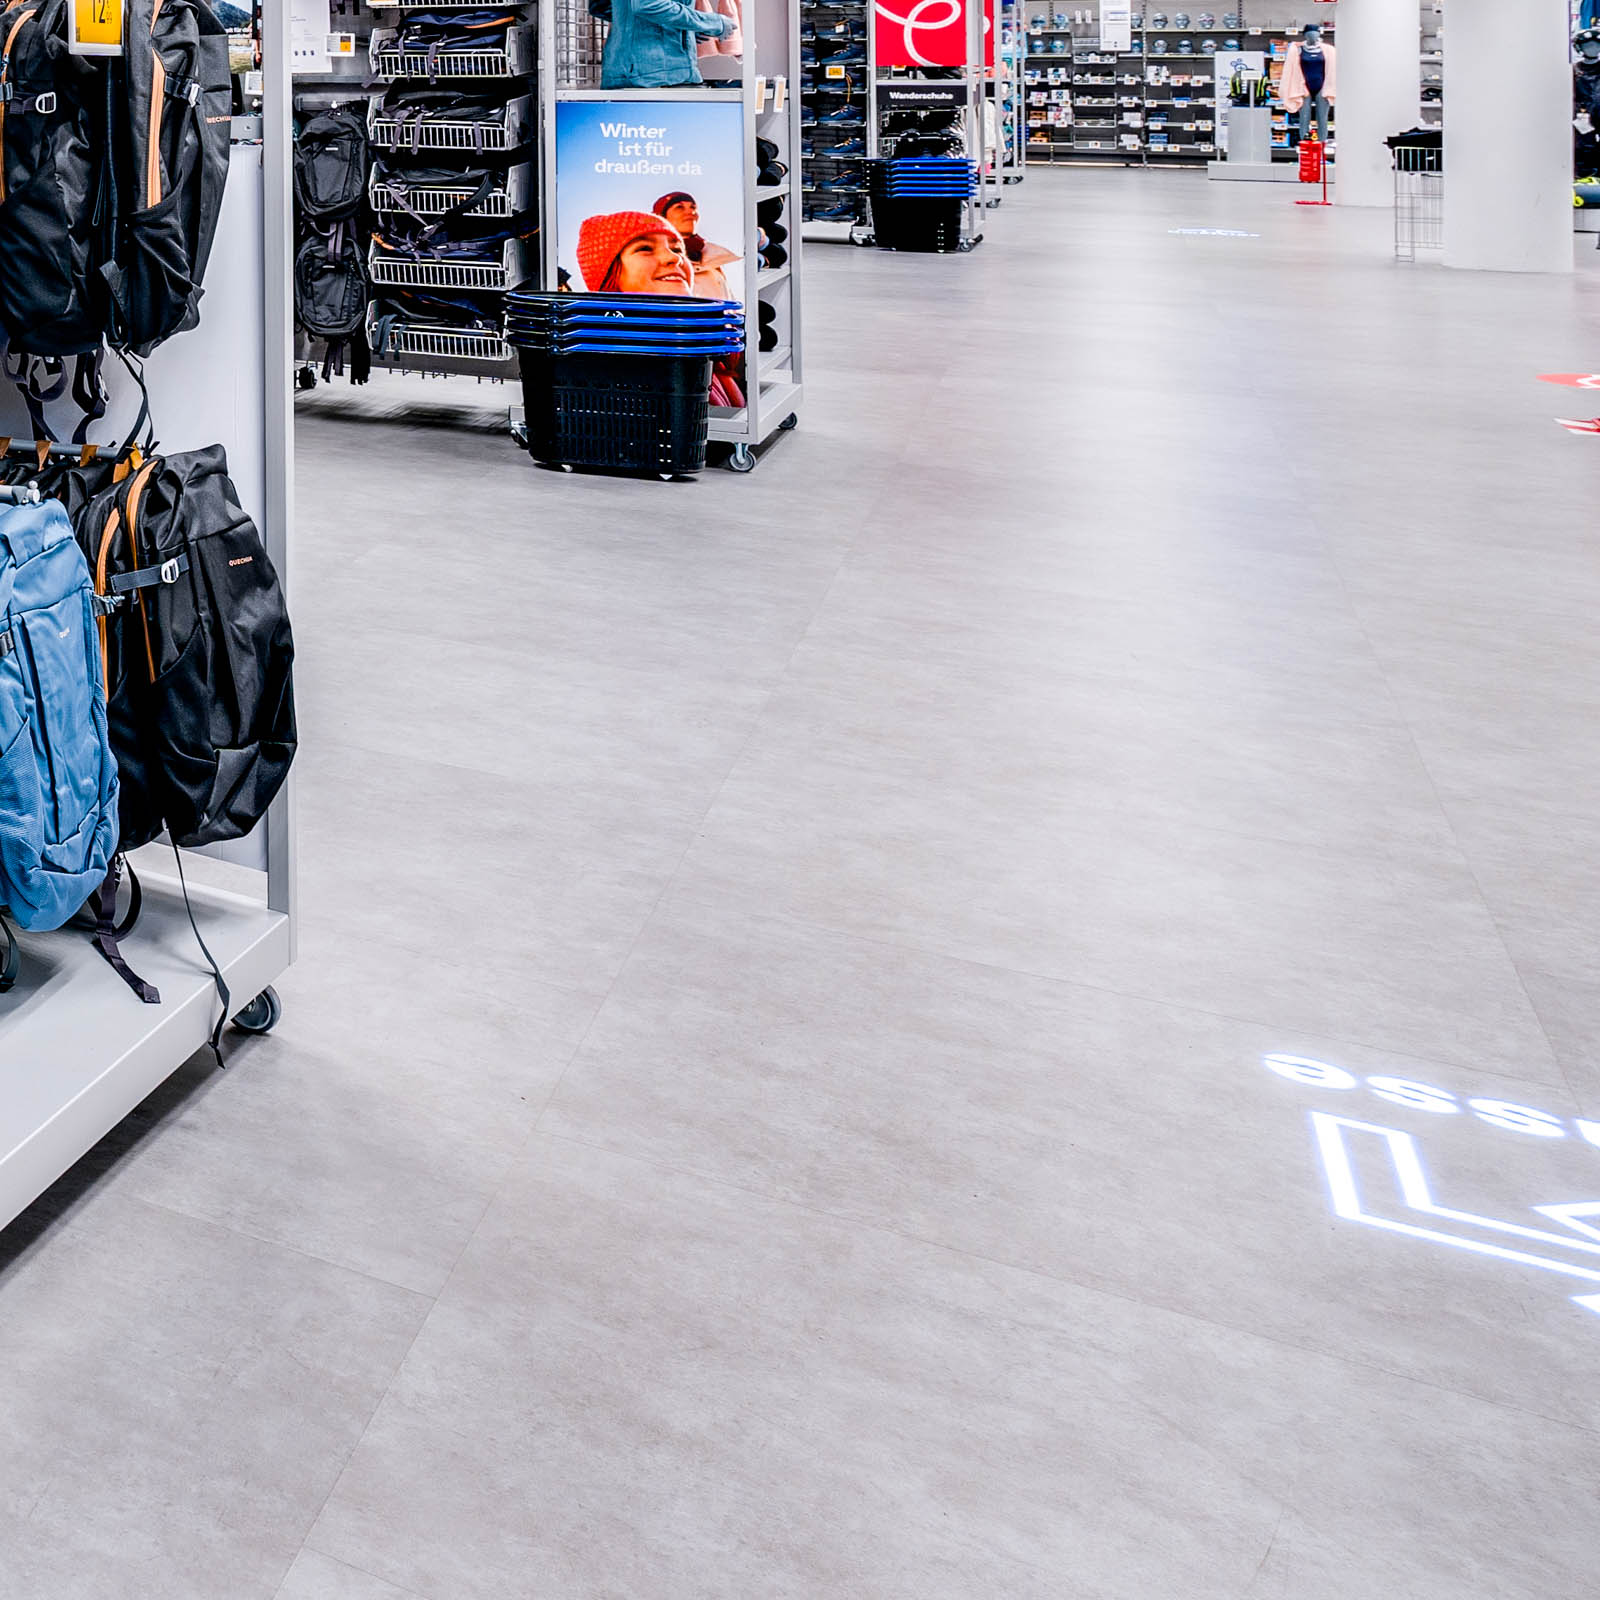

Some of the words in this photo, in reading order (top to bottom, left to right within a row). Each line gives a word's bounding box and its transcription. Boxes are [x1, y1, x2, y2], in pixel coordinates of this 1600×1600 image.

[600, 123, 667, 139] Winter
[618, 142, 642, 156] ist
[644, 142, 672, 157] für
[594, 159, 674, 176] draußen
[678, 160, 702, 176] da
